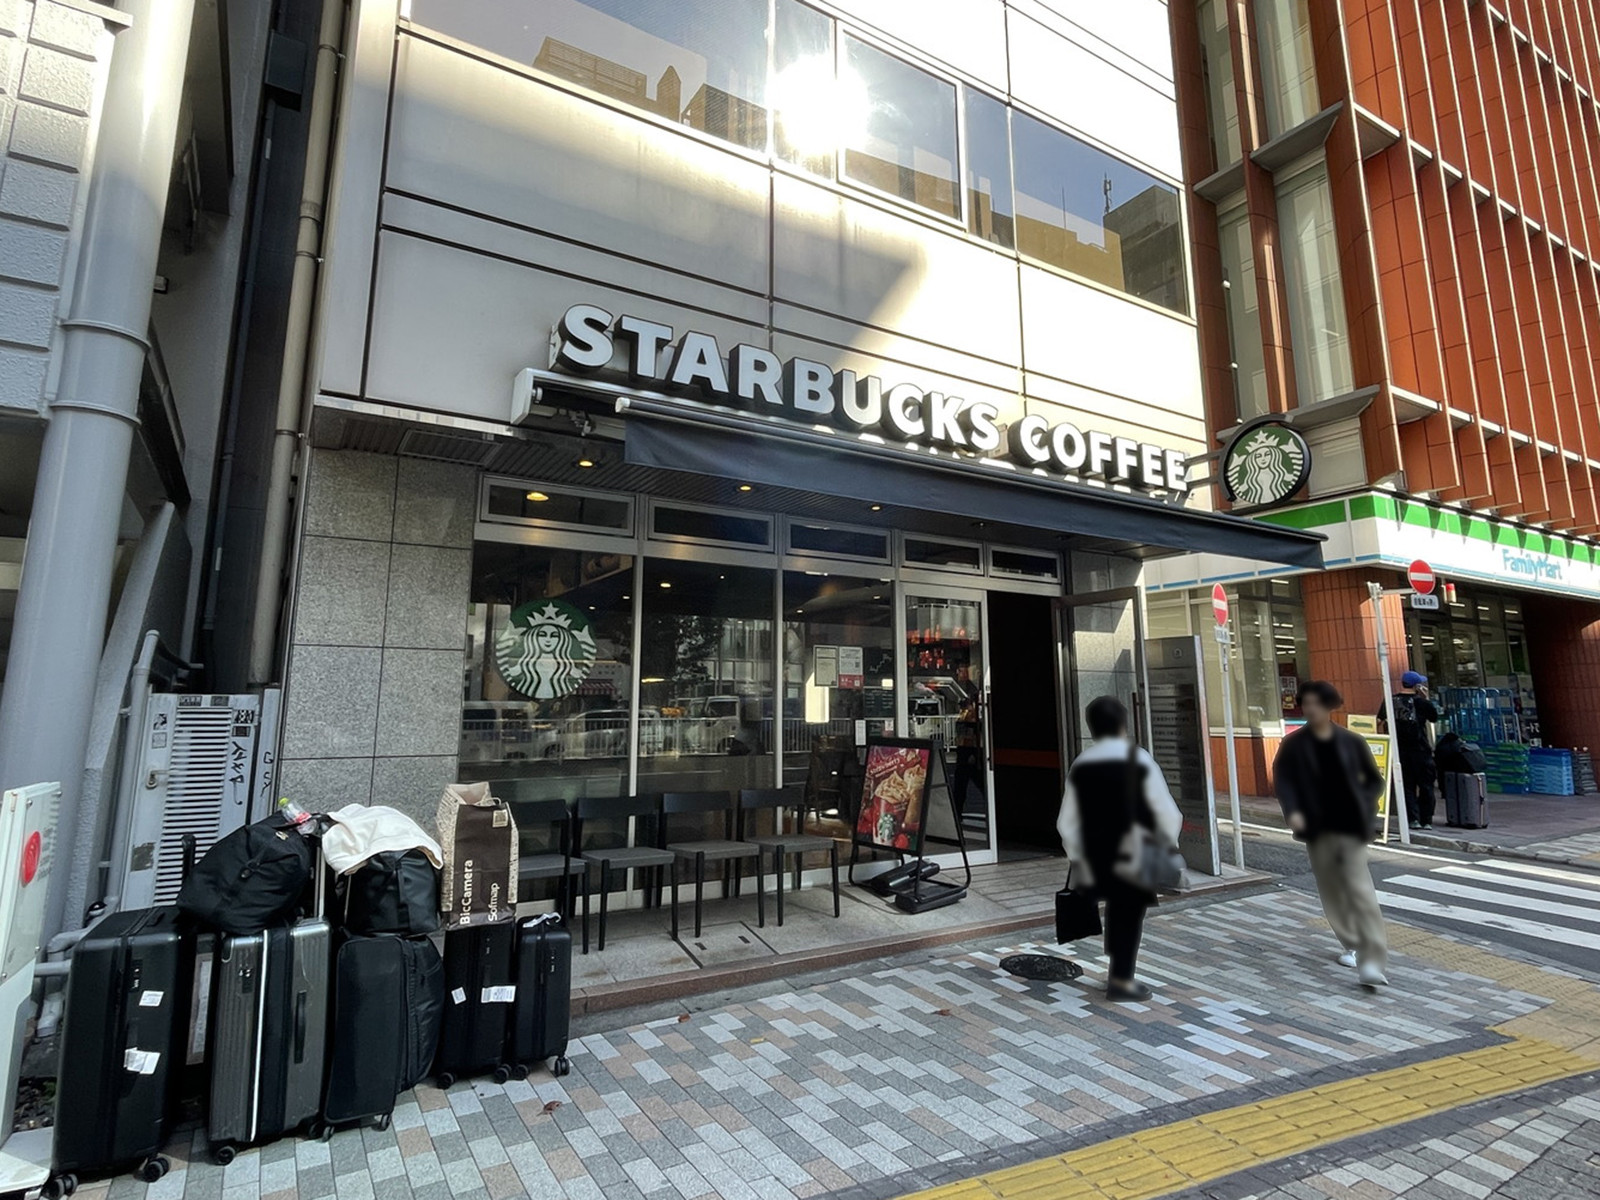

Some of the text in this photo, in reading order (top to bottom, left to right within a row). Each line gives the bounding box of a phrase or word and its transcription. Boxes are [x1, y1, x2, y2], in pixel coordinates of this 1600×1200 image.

[560, 304, 1187, 491] STARBUCKS COFFEE
[1502, 548, 1563, 582] FamilyMart
[460, 859, 474, 925] BicCamera
[488, 882, 501, 922] Sofmap
